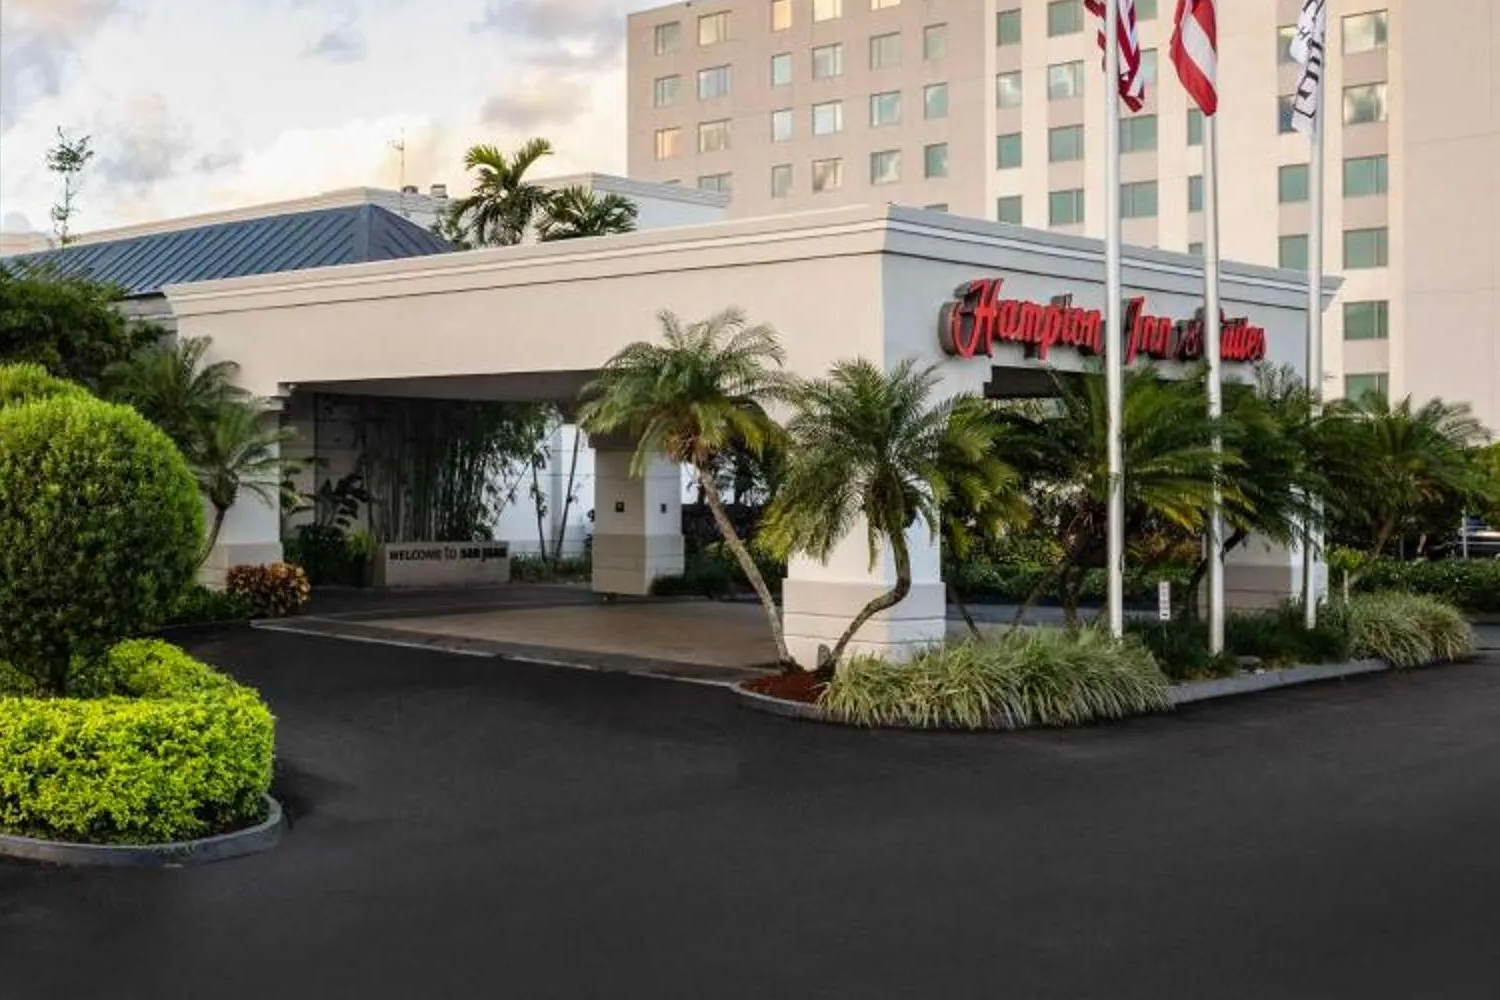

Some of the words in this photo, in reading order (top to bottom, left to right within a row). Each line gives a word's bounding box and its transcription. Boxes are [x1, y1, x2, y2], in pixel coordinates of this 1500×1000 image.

[938, 276, 1104, 361] Hampton
[1121, 294, 1174, 366] Inn
[389, 548, 442, 561] WELCOME
